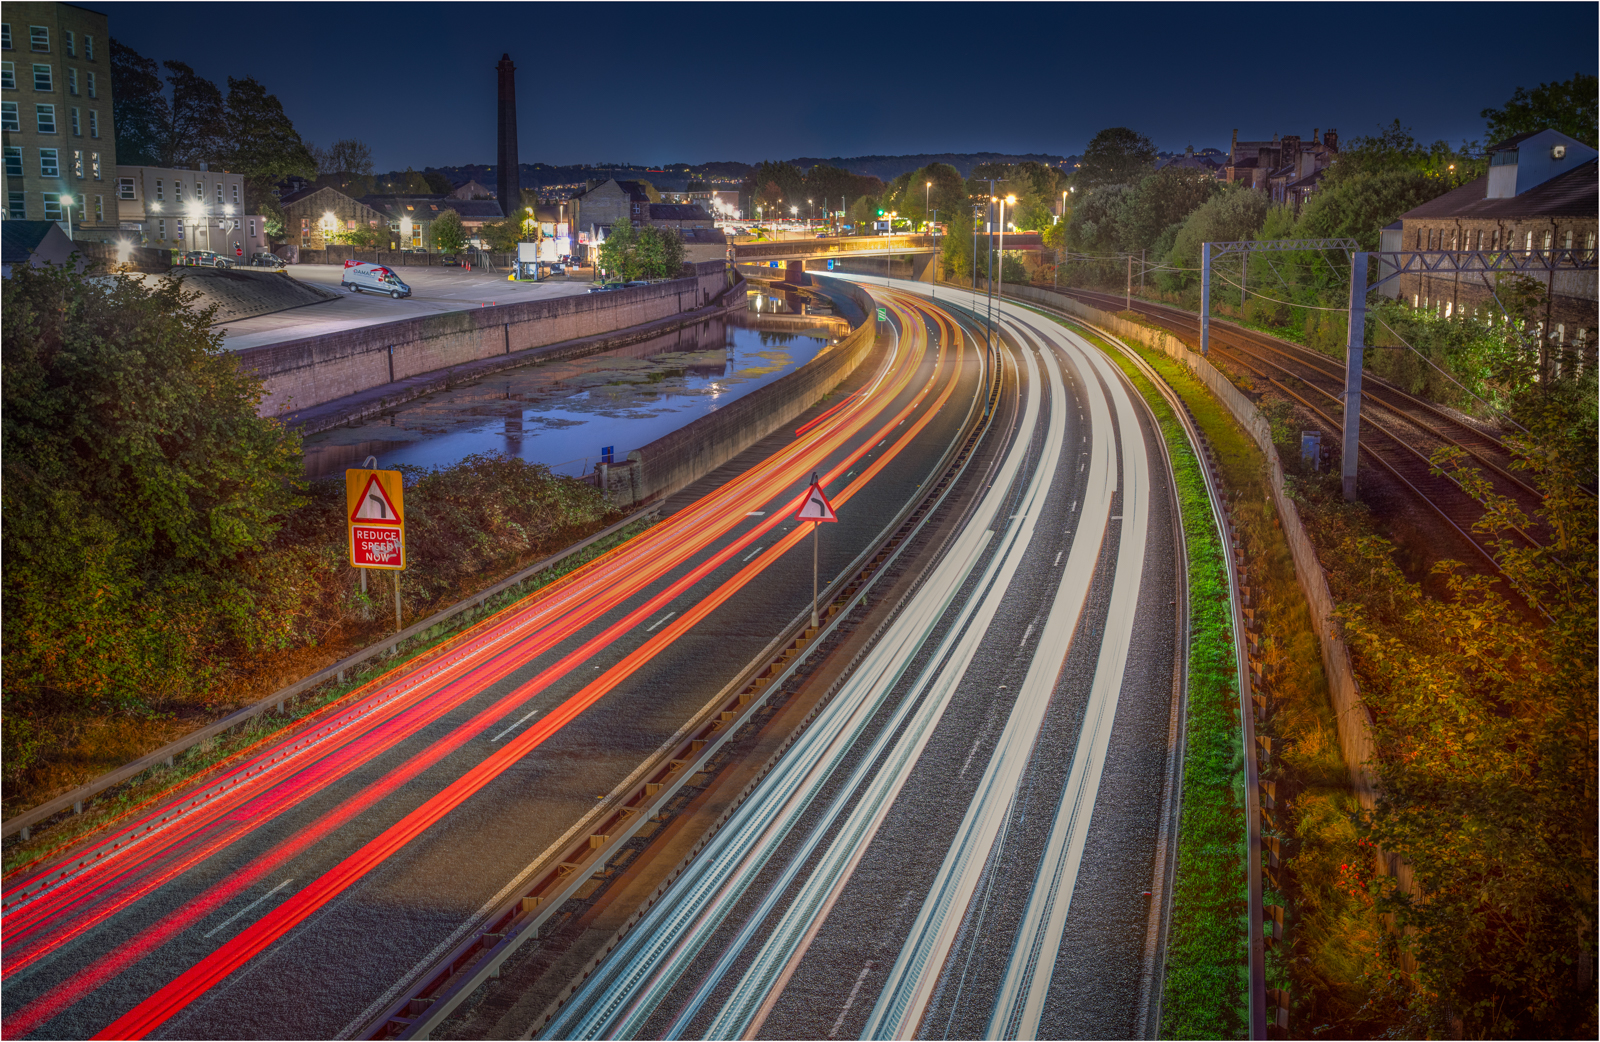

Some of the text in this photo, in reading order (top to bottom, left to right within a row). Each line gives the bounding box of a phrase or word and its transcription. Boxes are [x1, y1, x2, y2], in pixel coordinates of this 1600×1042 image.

[356, 530, 397, 541] REDUCE
[361, 541, 394, 552] SPEED
[365, 552, 390, 563] NOW
